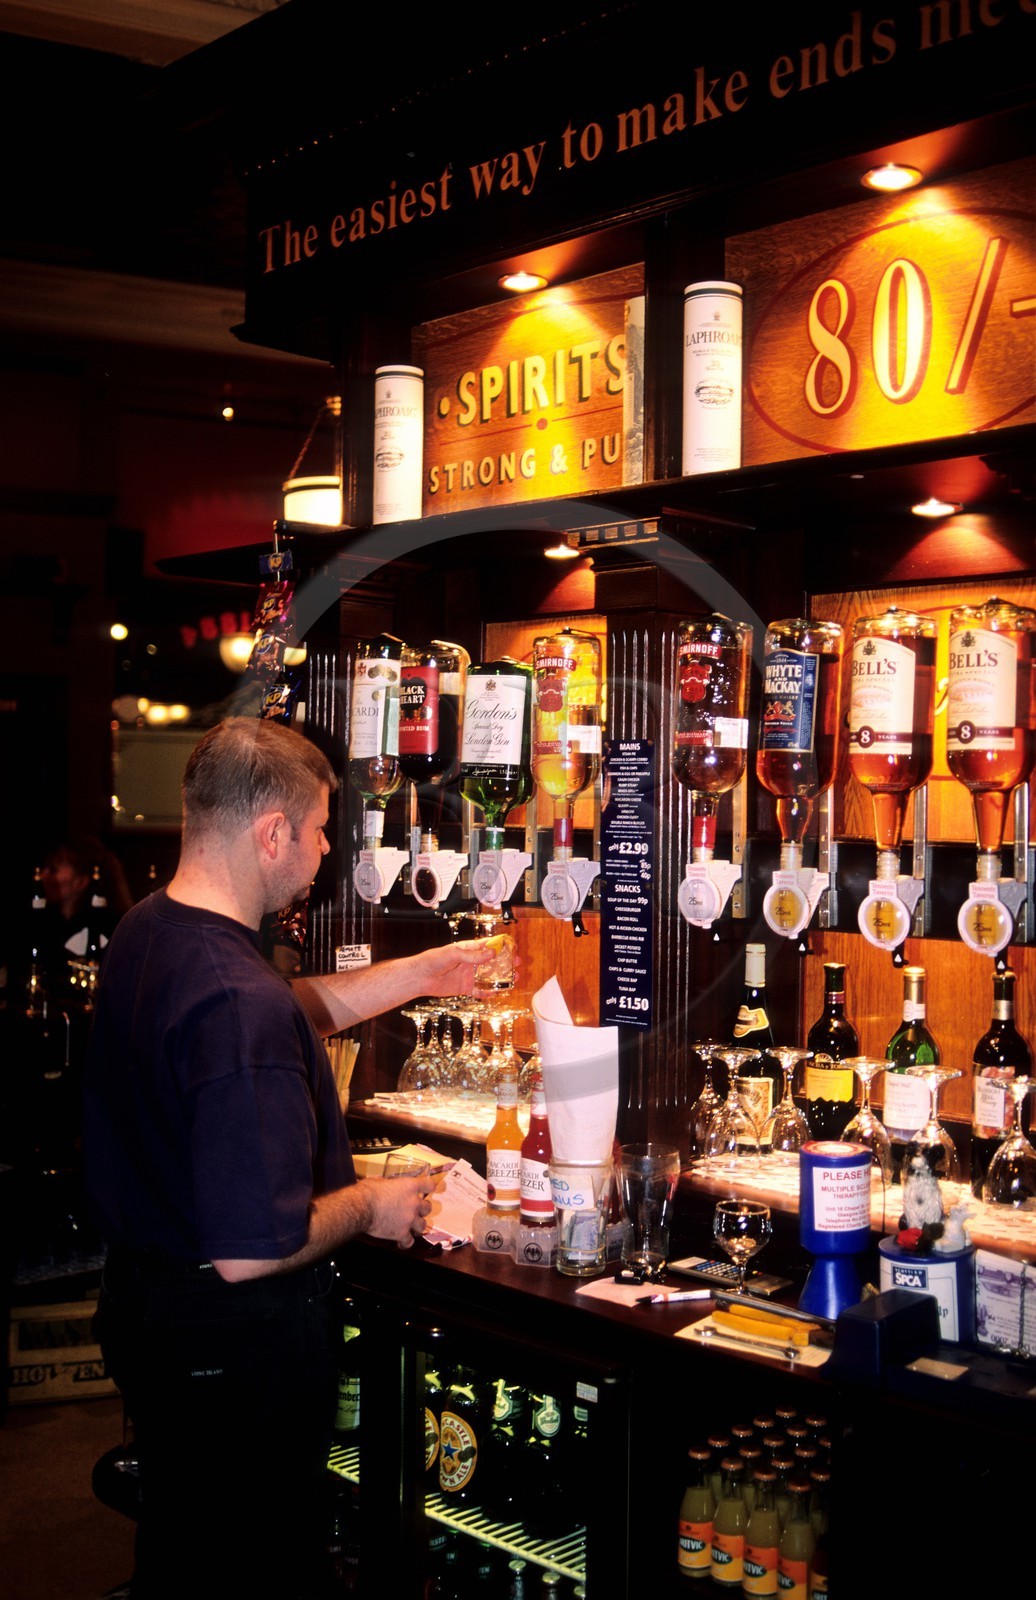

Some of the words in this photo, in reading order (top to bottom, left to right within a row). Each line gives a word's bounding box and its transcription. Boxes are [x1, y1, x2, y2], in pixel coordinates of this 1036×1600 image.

[259, 219, 319, 274] The
[330, 164, 453, 248] easiest
[469, 140, 547, 199] way
[562, 118, 604, 169] to
[616, 66, 749, 153] make
[769, 10, 897, 98] ends
[457, 334, 625, 427] SPIRITS
[429, 448, 536, 494] STRONG
[550, 443, 569, 475] &
[536, 658, 574, 670] SMIRNOFF
[950, 649, 999, 670] BELL'S
[766, 664, 802, 678] WHYTE
[852, 658, 898, 677] BELL'S
[764, 680, 802, 694] MACKAY
[265, 692, 282, 706] KP
[466, 698, 518, 721] Gordon's
[464, 732, 493, 745] London
[492, 732, 510, 746] Gin
[860, 730, 870, 744] 8
[960, 725, 971, 739] 8
[619, 743, 641, 751] MAINS
[619, 842, 649, 855] £2.99
[615, 885, 641, 893] SNACKS
[637, 897, 648, 905] 99p
[873, 917, 890, 927] 25ml
[973, 922, 991, 932] 25ml
[606, 996, 617, 1005] only
[619, 996, 649, 1011] £1.50
[490, 1161, 519, 1169] BACARDI
[823, 1170, 862, 1181] PLEASE
[895, 1272, 922, 1287] SPCA
[457, 1464, 470, 1480] ALE
